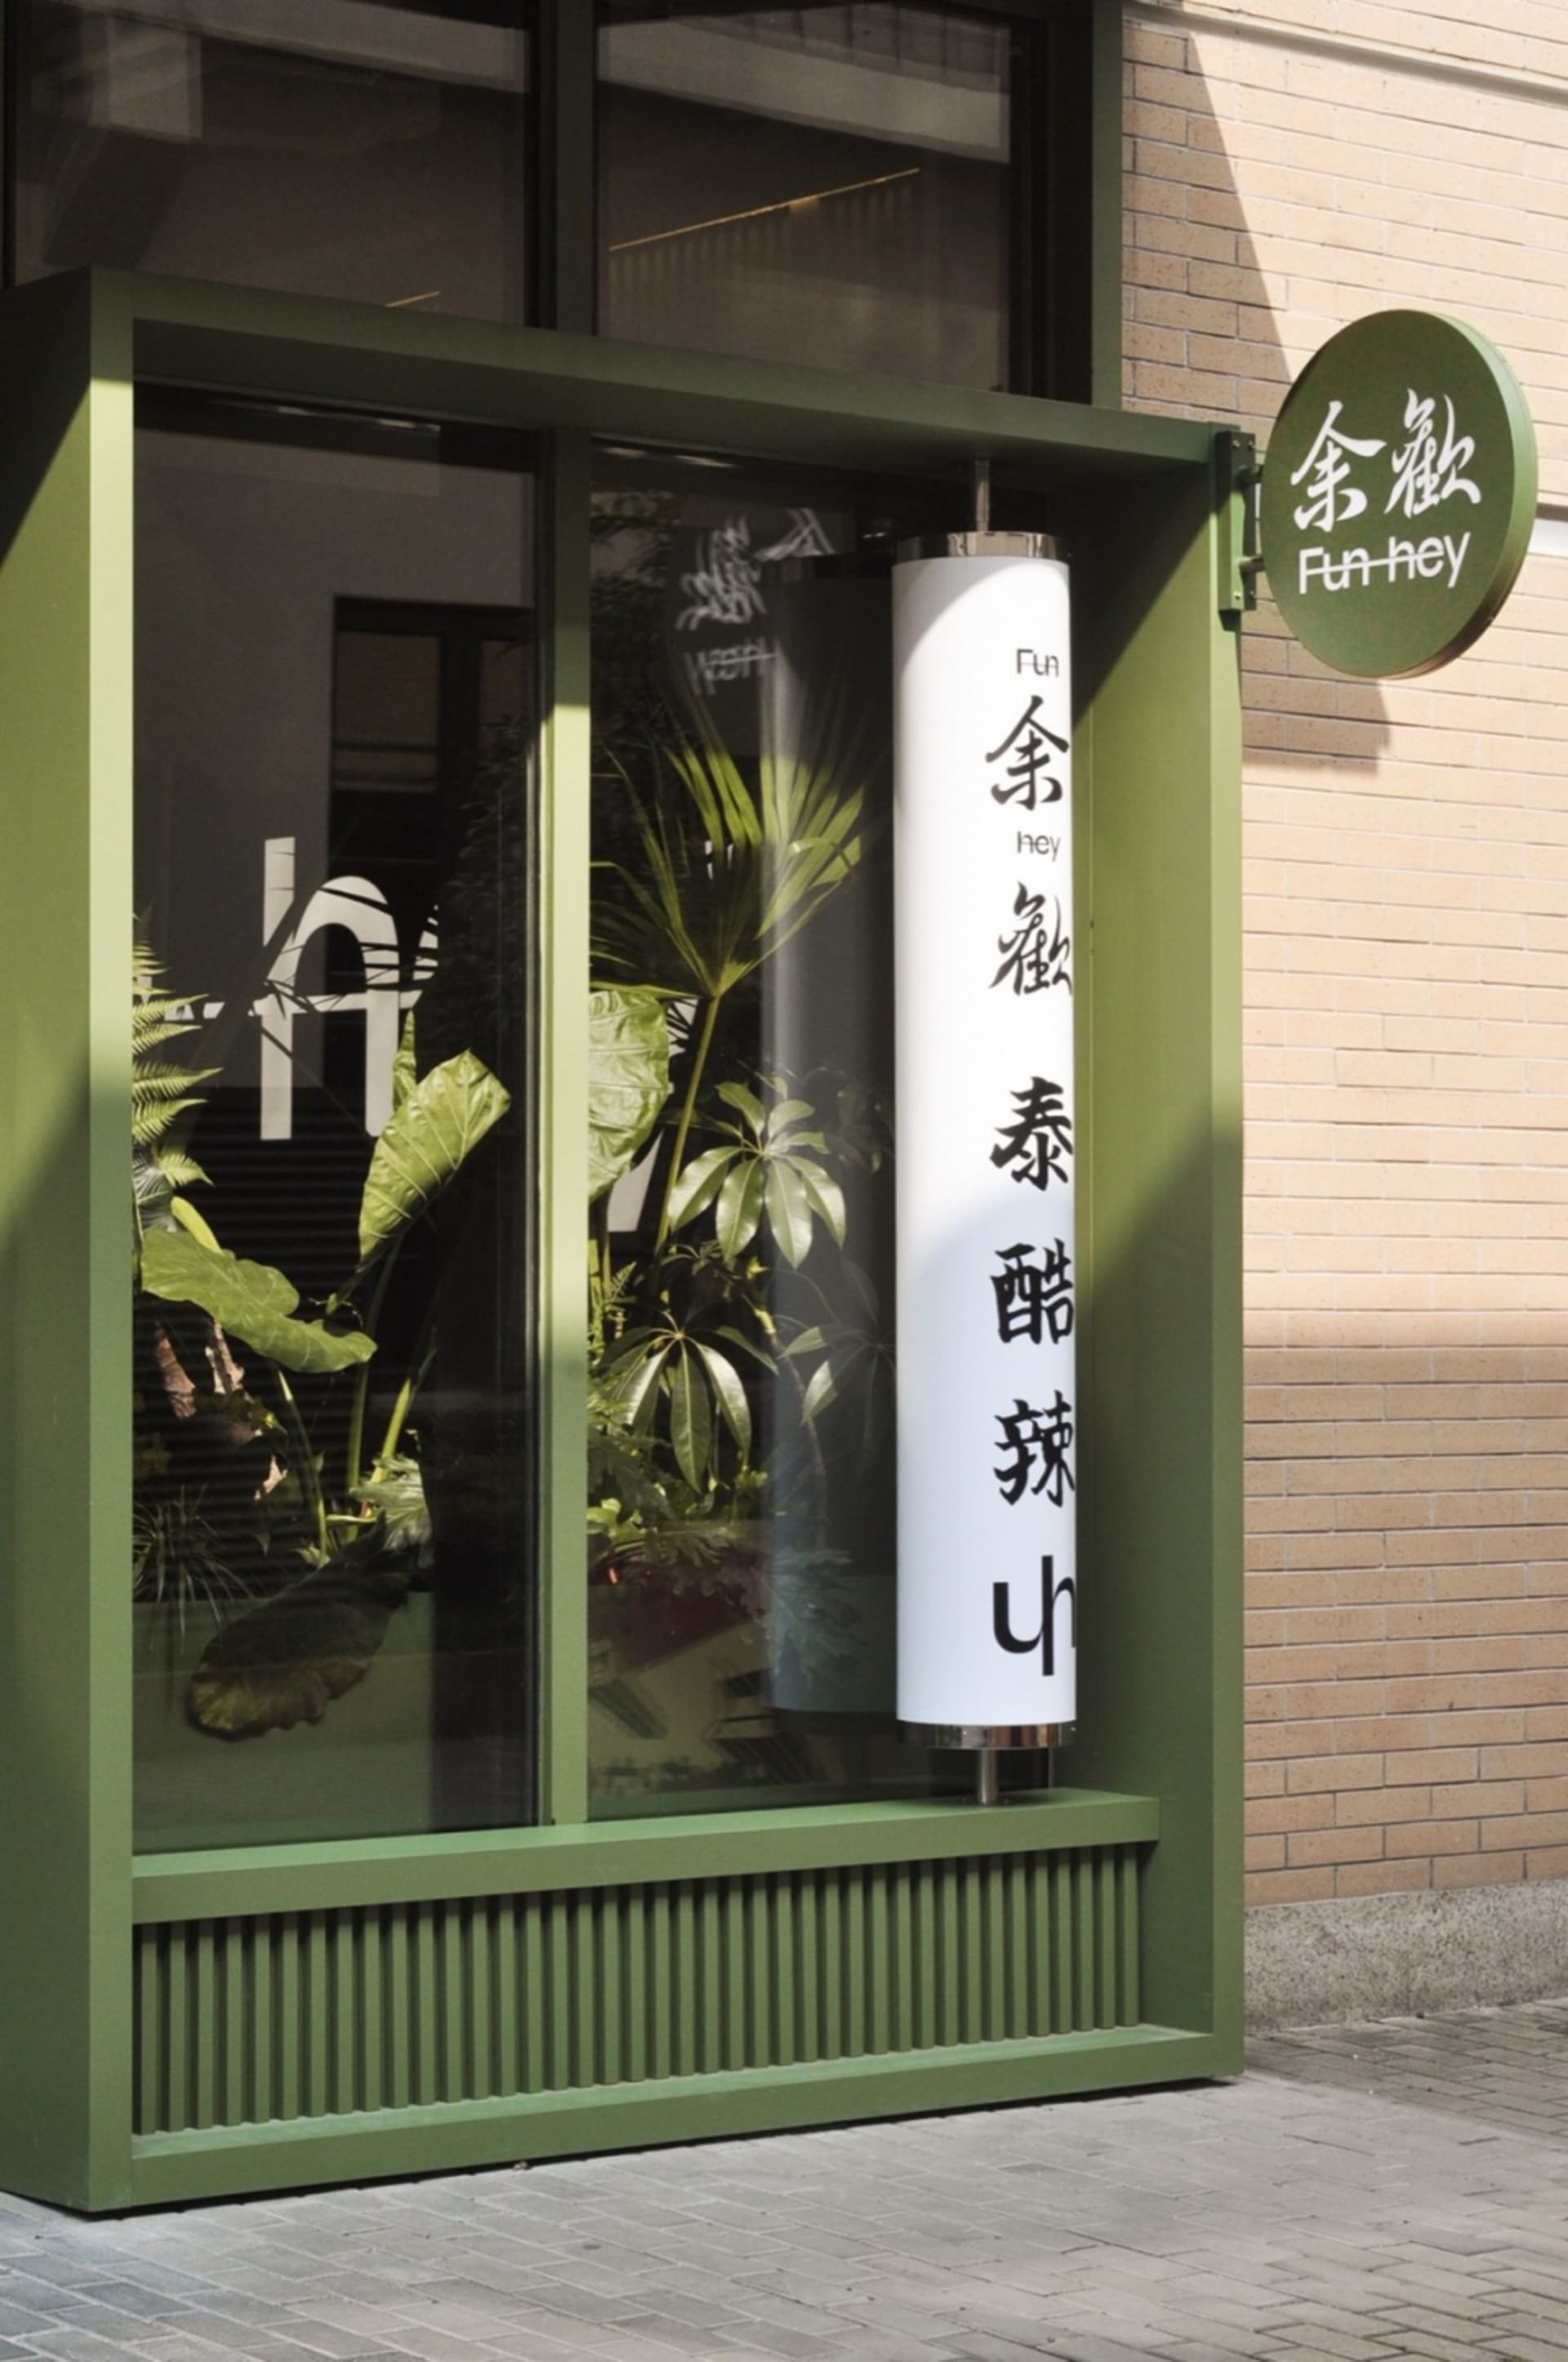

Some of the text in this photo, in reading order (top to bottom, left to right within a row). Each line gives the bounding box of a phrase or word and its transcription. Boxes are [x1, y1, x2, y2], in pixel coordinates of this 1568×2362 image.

[1299, 532, 1471, 595] Fun hey
[1016, 648, 1059, 677] Fun
[985, 694, 1070, 811] 余
[1017, 831, 1061, 862] hey
[989, 1076, 1076, 1508] 泰酷辣
